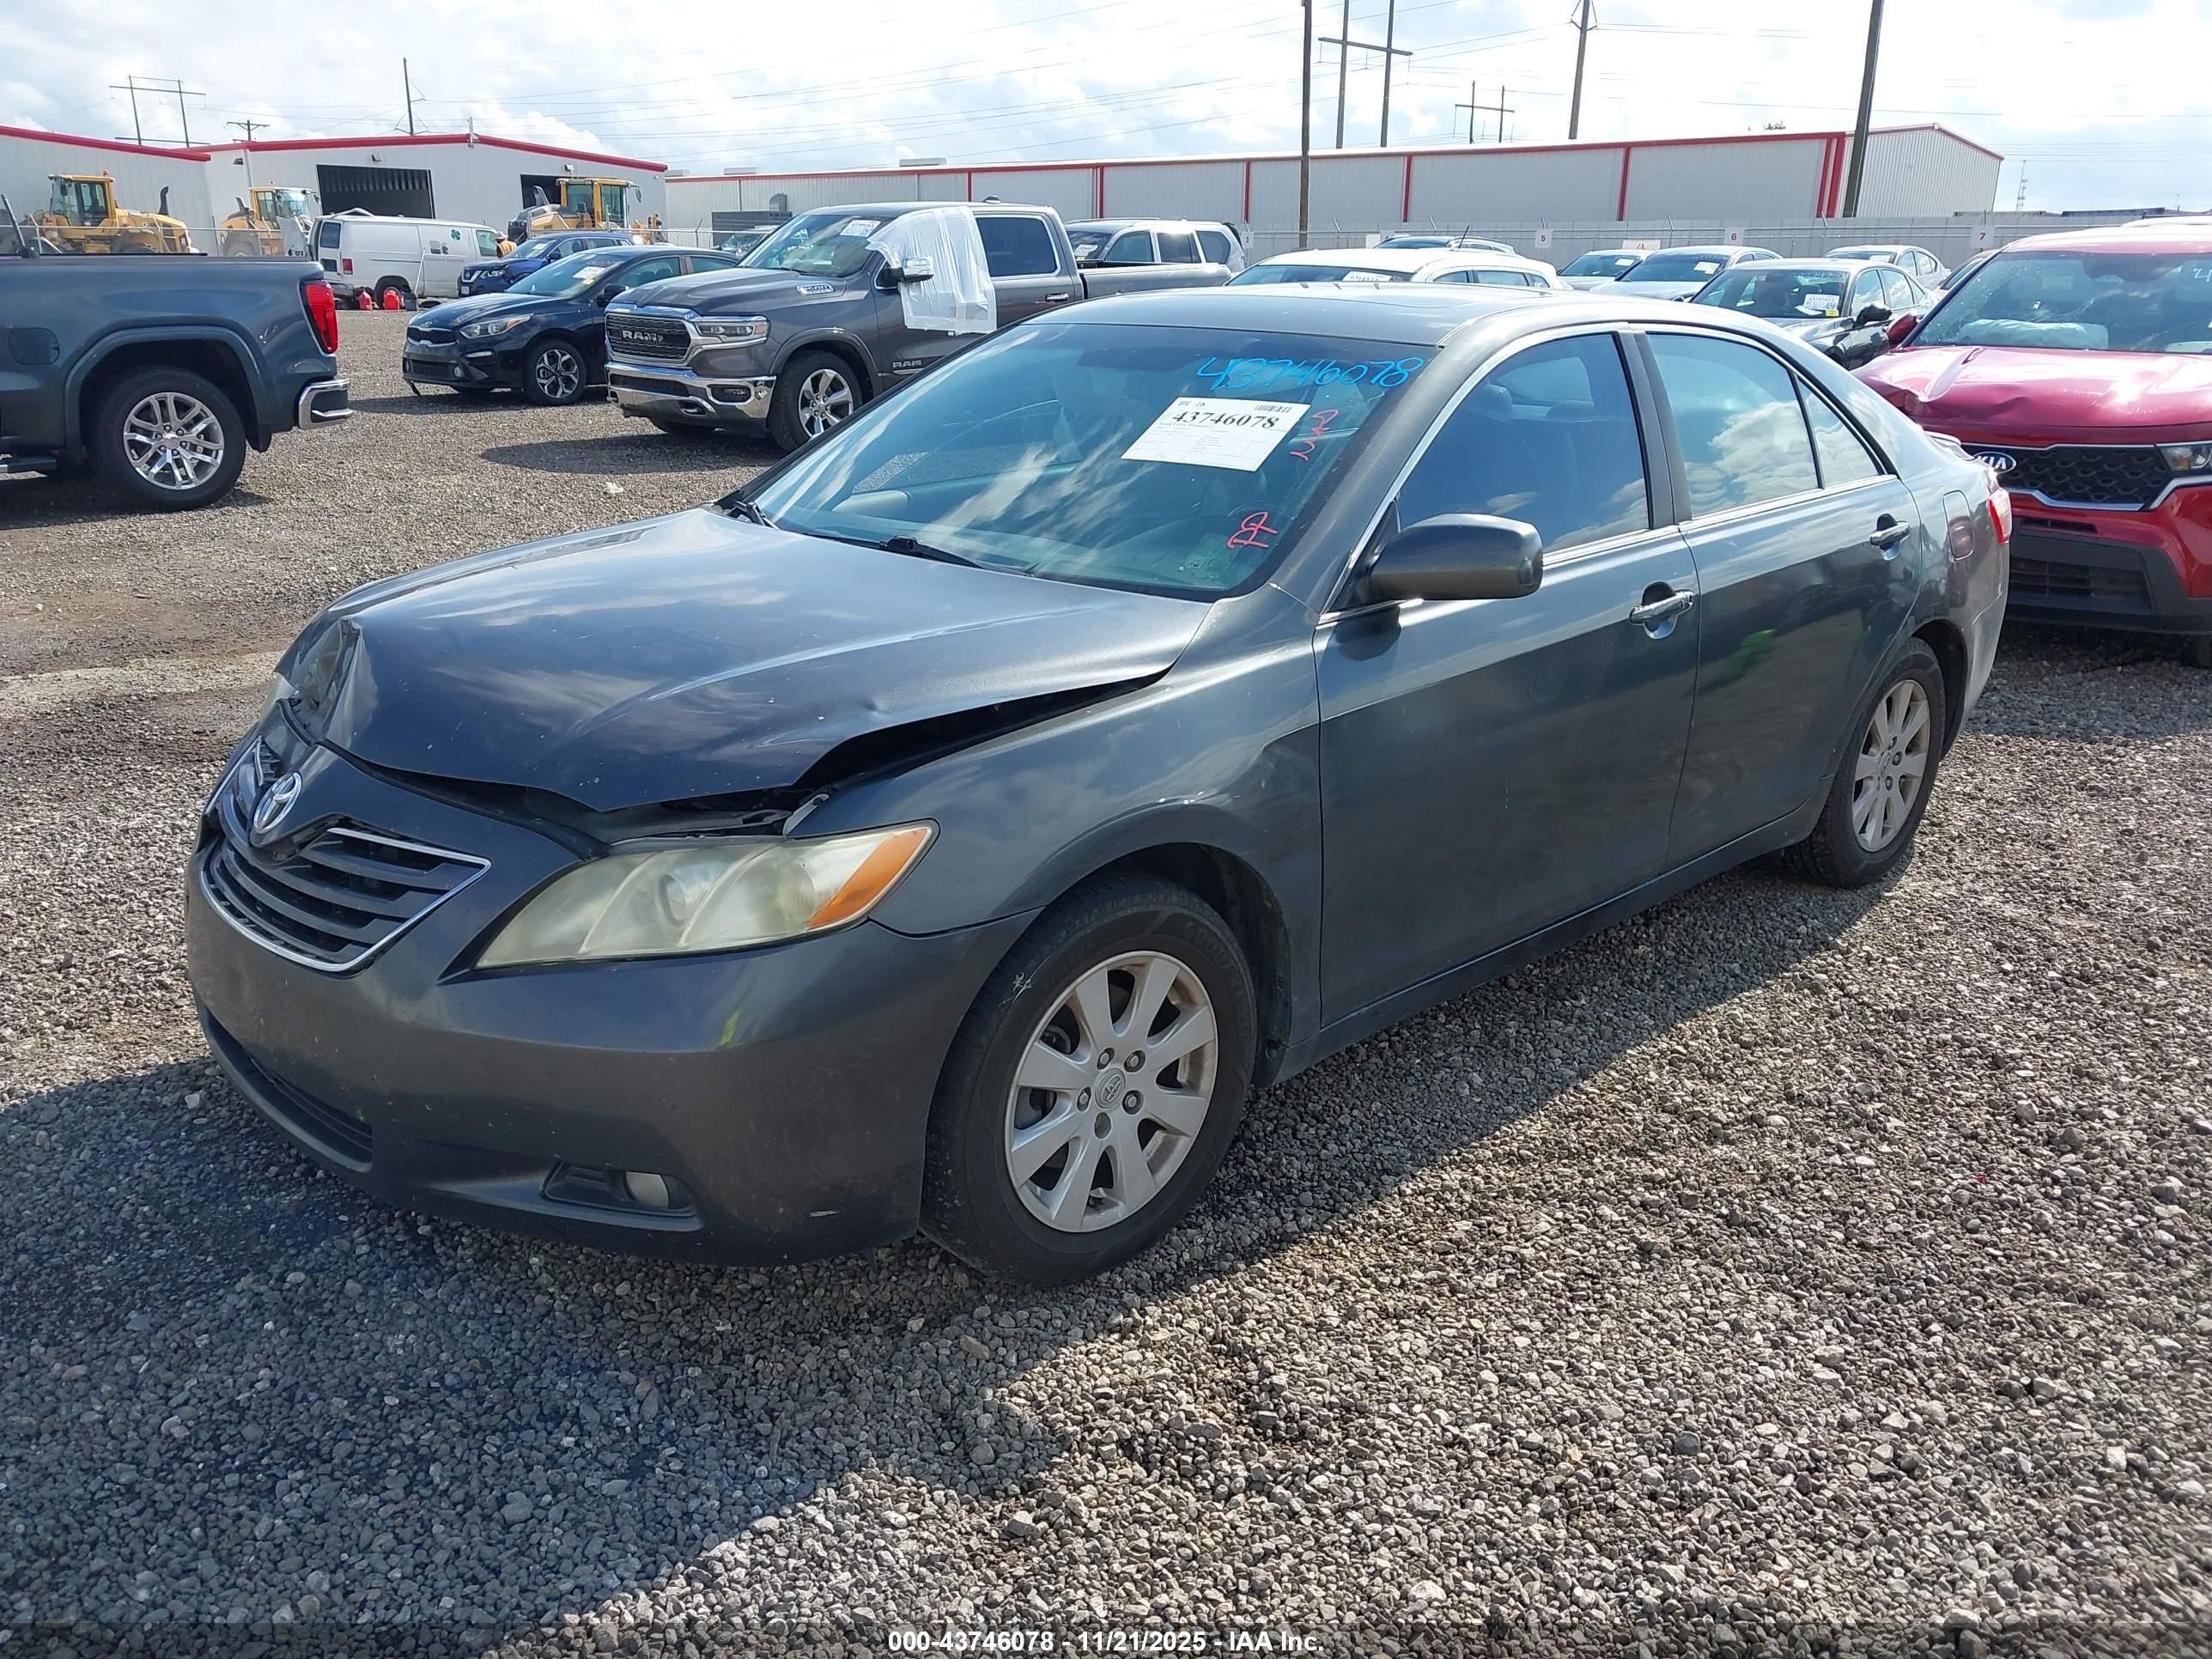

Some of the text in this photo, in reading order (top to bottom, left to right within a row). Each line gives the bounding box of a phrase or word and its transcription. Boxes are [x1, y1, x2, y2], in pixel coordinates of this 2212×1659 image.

[1730, 233, 1737, 241] 6
[1979, 232, 1986, 240] 7
[622, 330, 659, 342] RAM
[893, 360, 922, 368] RAM
[1197, 356, 1425, 391] 43746078
[1172, 410, 1280, 429] 43746078
